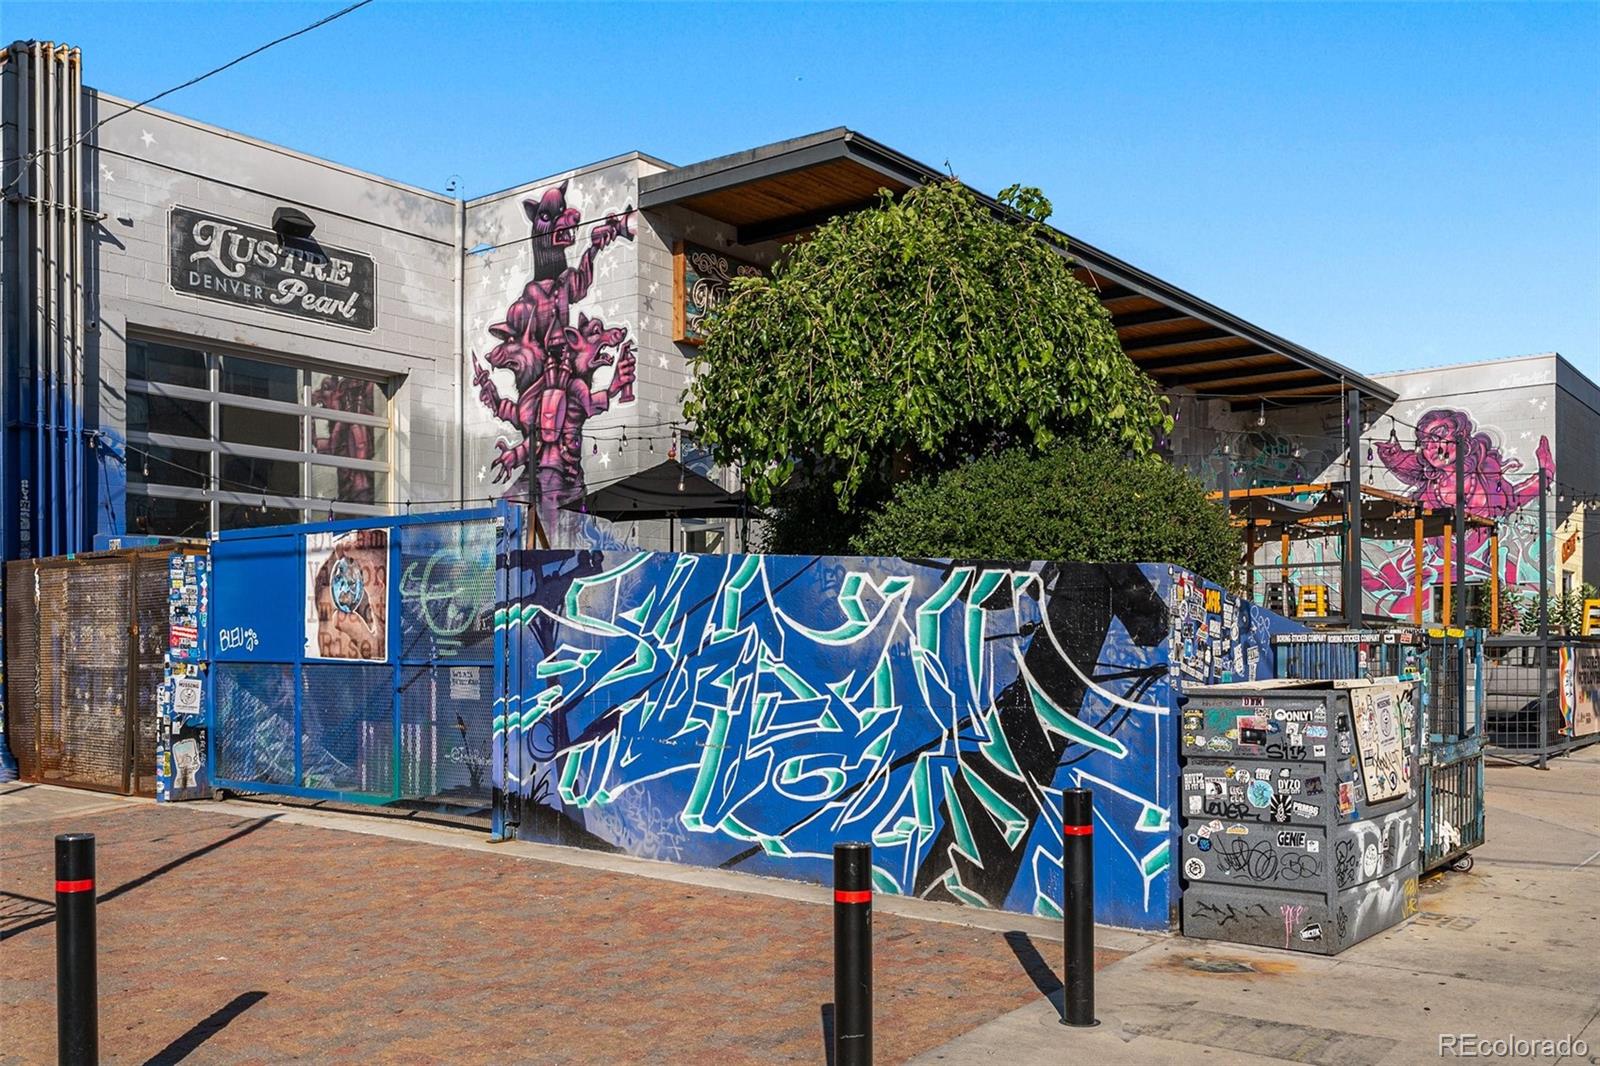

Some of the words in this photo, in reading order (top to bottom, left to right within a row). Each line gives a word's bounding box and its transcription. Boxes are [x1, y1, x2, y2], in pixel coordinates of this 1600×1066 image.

[190, 219, 354, 287] LUSTRE
[189, 271, 264, 300] DENVER
[270, 278, 360, 319] Pearl
[219, 627, 244, 651] BLEU
[1278, 831, 1305, 846] GENIE
